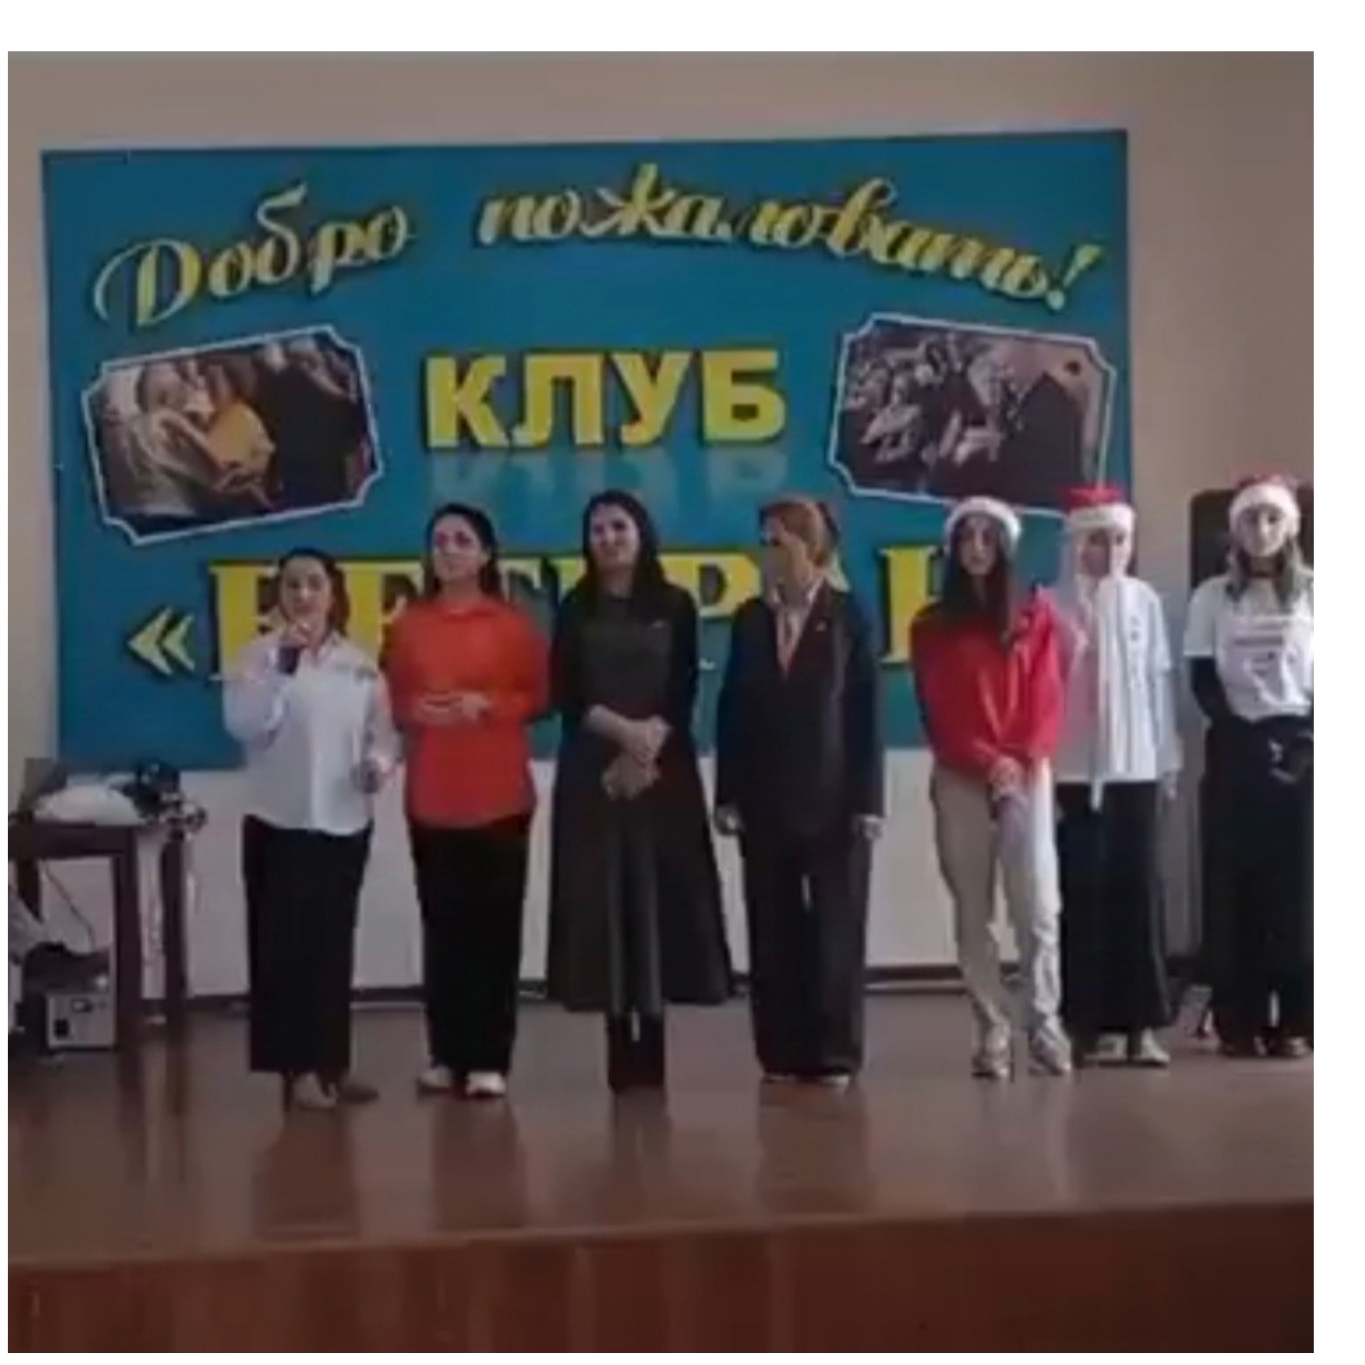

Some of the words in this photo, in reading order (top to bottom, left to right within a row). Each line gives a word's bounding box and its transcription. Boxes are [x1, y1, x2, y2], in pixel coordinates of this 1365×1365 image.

[93, 182, 417, 326] Добро
[477, 162, 1103, 310] пожаловать!
[425, 347, 787, 450] КЛУБ
